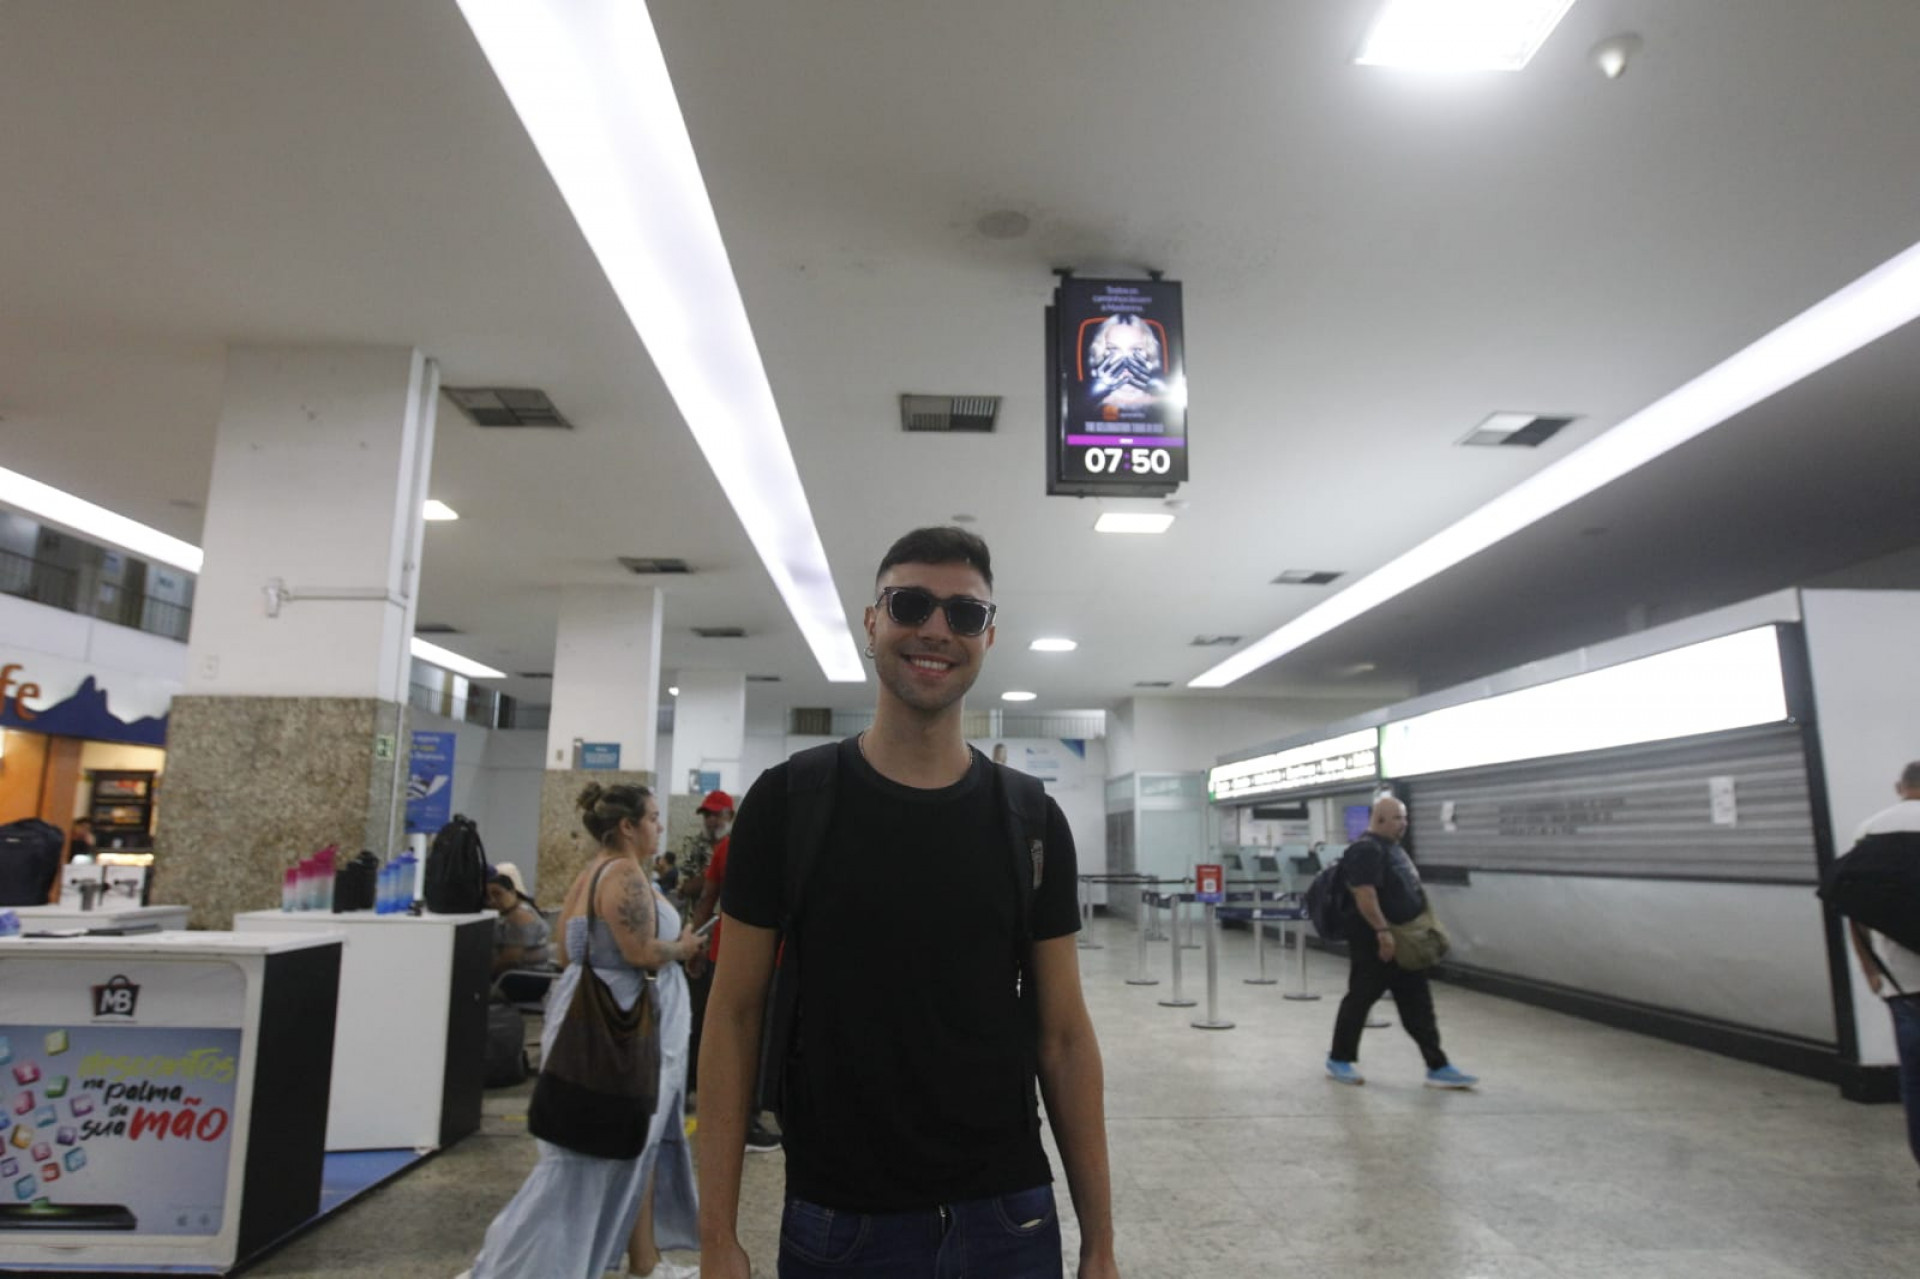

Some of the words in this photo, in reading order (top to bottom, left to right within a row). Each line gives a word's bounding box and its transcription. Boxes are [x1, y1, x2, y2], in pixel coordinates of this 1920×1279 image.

[1085, 447, 1171, 475] 07:50
[100, 989, 132, 1012] MB
[77, 1047, 235, 1083] descontos
[82, 1077, 105, 1090] na
[104, 1080, 183, 1105] palma
[79, 1118, 127, 1141] sua
[128, 1096, 228, 1142] mão
